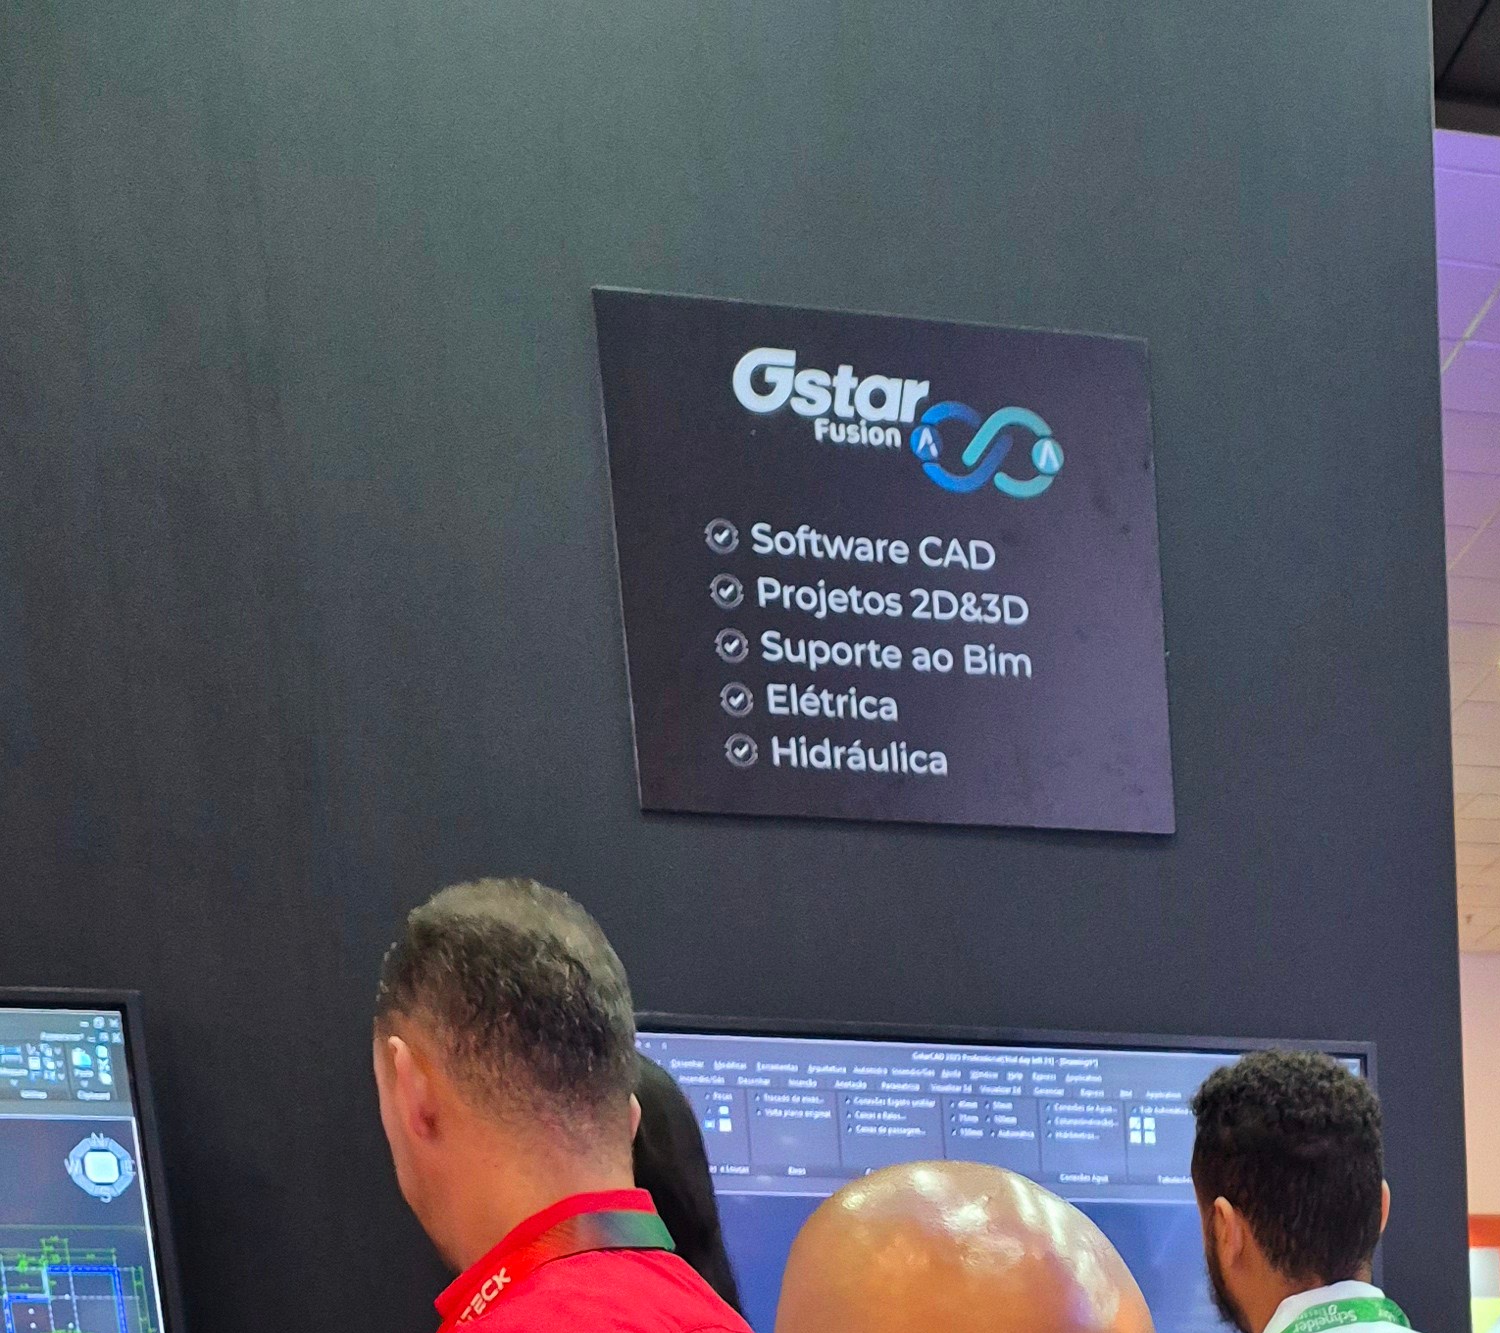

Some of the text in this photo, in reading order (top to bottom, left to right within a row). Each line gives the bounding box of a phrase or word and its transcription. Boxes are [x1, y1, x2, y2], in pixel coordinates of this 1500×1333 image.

[732, 346, 929, 423] Gstar
[814, 417, 901, 448] Fusion
[751, 522, 996, 571] Software CAD
[756, 576, 1030, 626] Projetos 2D&3D
[760, 629, 1033, 678] Suporte ao Bim
[766, 682, 899, 722] Elétrica
[771, 735, 948, 775] Hidráulica
[456, 1267, 512, 1326] TECK
[1292, 1309, 1358, 1333] Schneider
